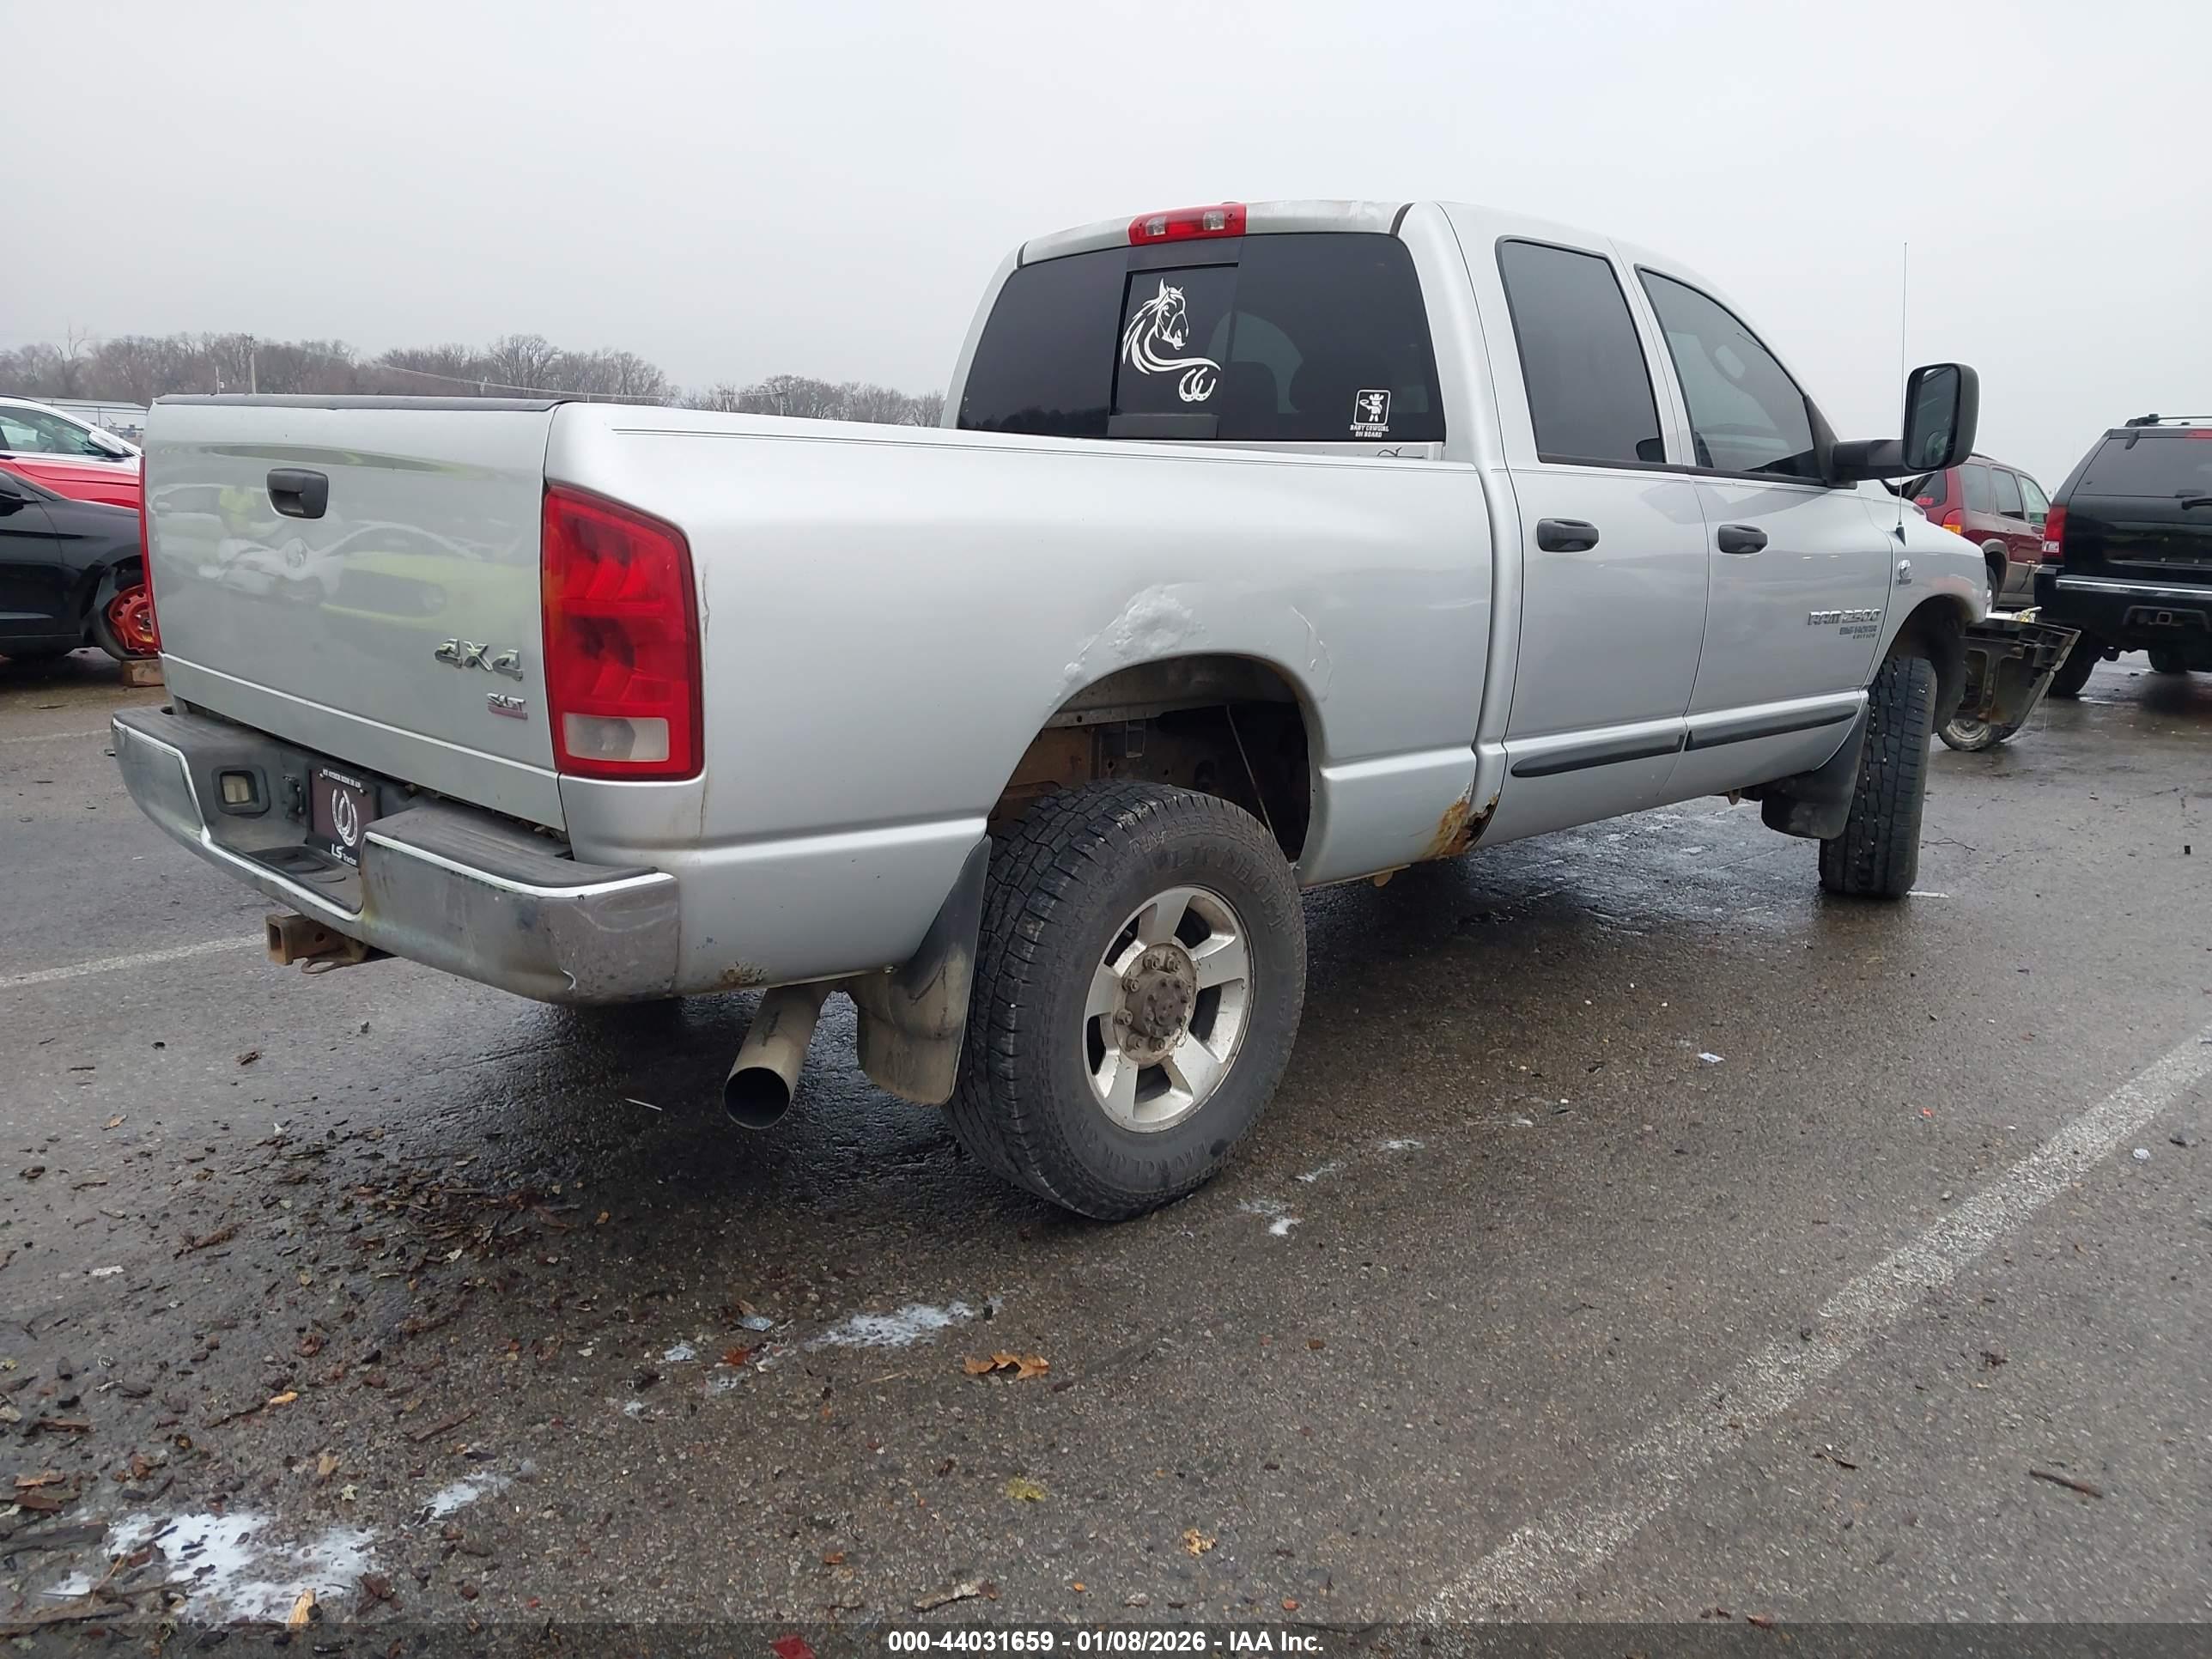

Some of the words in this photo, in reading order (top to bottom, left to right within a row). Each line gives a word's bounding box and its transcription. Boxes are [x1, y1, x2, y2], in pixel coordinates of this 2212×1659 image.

[1808, 611, 1841, 625] RAM
[1842, 609, 1881, 623] 2500
[487, 692, 526, 712] SLT
[331, 843, 344, 859] LS
